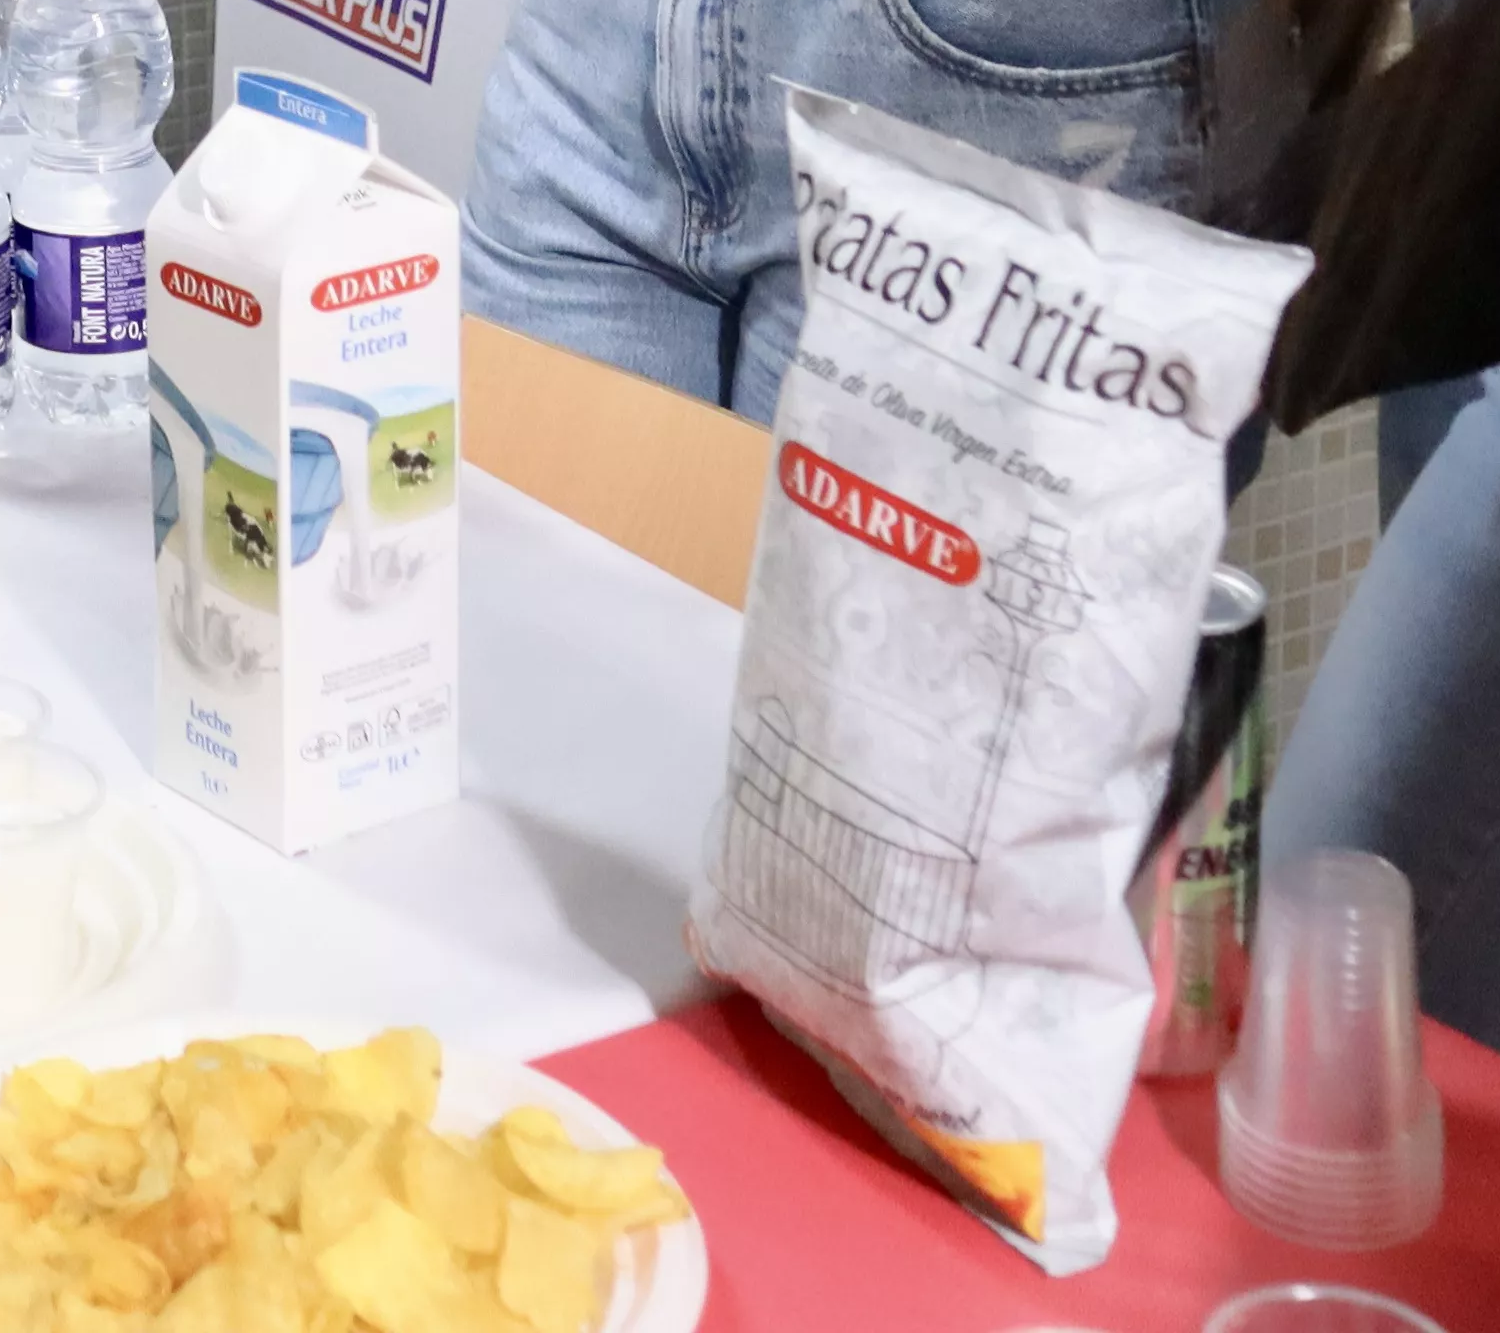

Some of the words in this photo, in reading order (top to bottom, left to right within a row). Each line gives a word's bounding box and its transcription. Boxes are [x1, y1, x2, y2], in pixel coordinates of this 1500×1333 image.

[277, 90, 327, 126] Entera
[80, 245, 106, 303] NATURA
[169, 267, 254, 322] ADARVE
[321, 259, 430, 308] ADARVE
[81, 306, 107, 344] FONT
[349, 304, 403, 332] Leche
[973, 258, 1197, 419] Fritas
[341, 331, 408, 363] Entera
[797, 348, 839, 381] ceite
[871, 382, 925, 428] Oliva
[931, 411, 998, 464] Virgen
[1002, 449, 1074, 495] Extra
[786, 456, 960, 577] ADARVE
[189, 698, 233, 737] Leche
[185, 721, 239, 768] Entera
